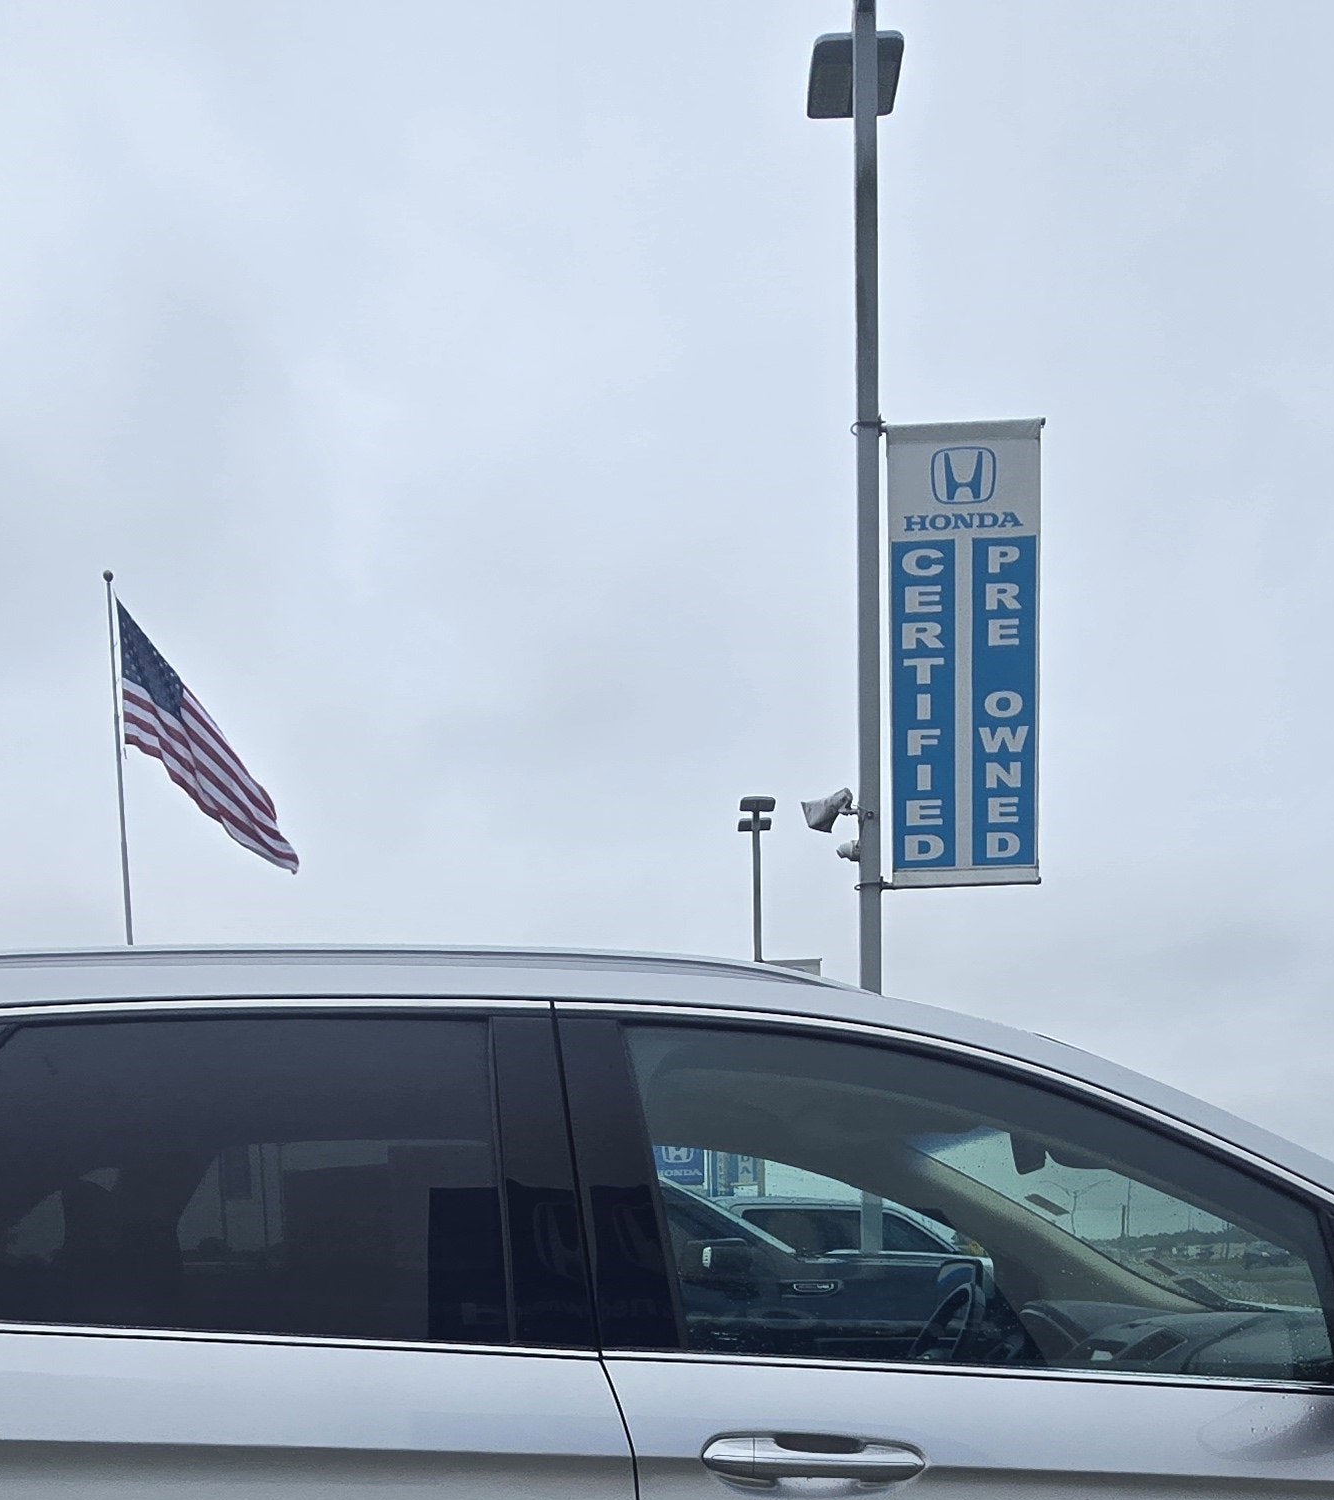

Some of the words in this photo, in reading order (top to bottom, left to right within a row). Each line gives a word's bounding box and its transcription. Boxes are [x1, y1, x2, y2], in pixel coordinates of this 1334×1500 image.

[903, 511, 1024, 532] HONDA
[985, 545, 1023, 647] PRE
[900, 548, 946, 862] CERTIFIED
[978, 690, 1030, 859] OWNED
